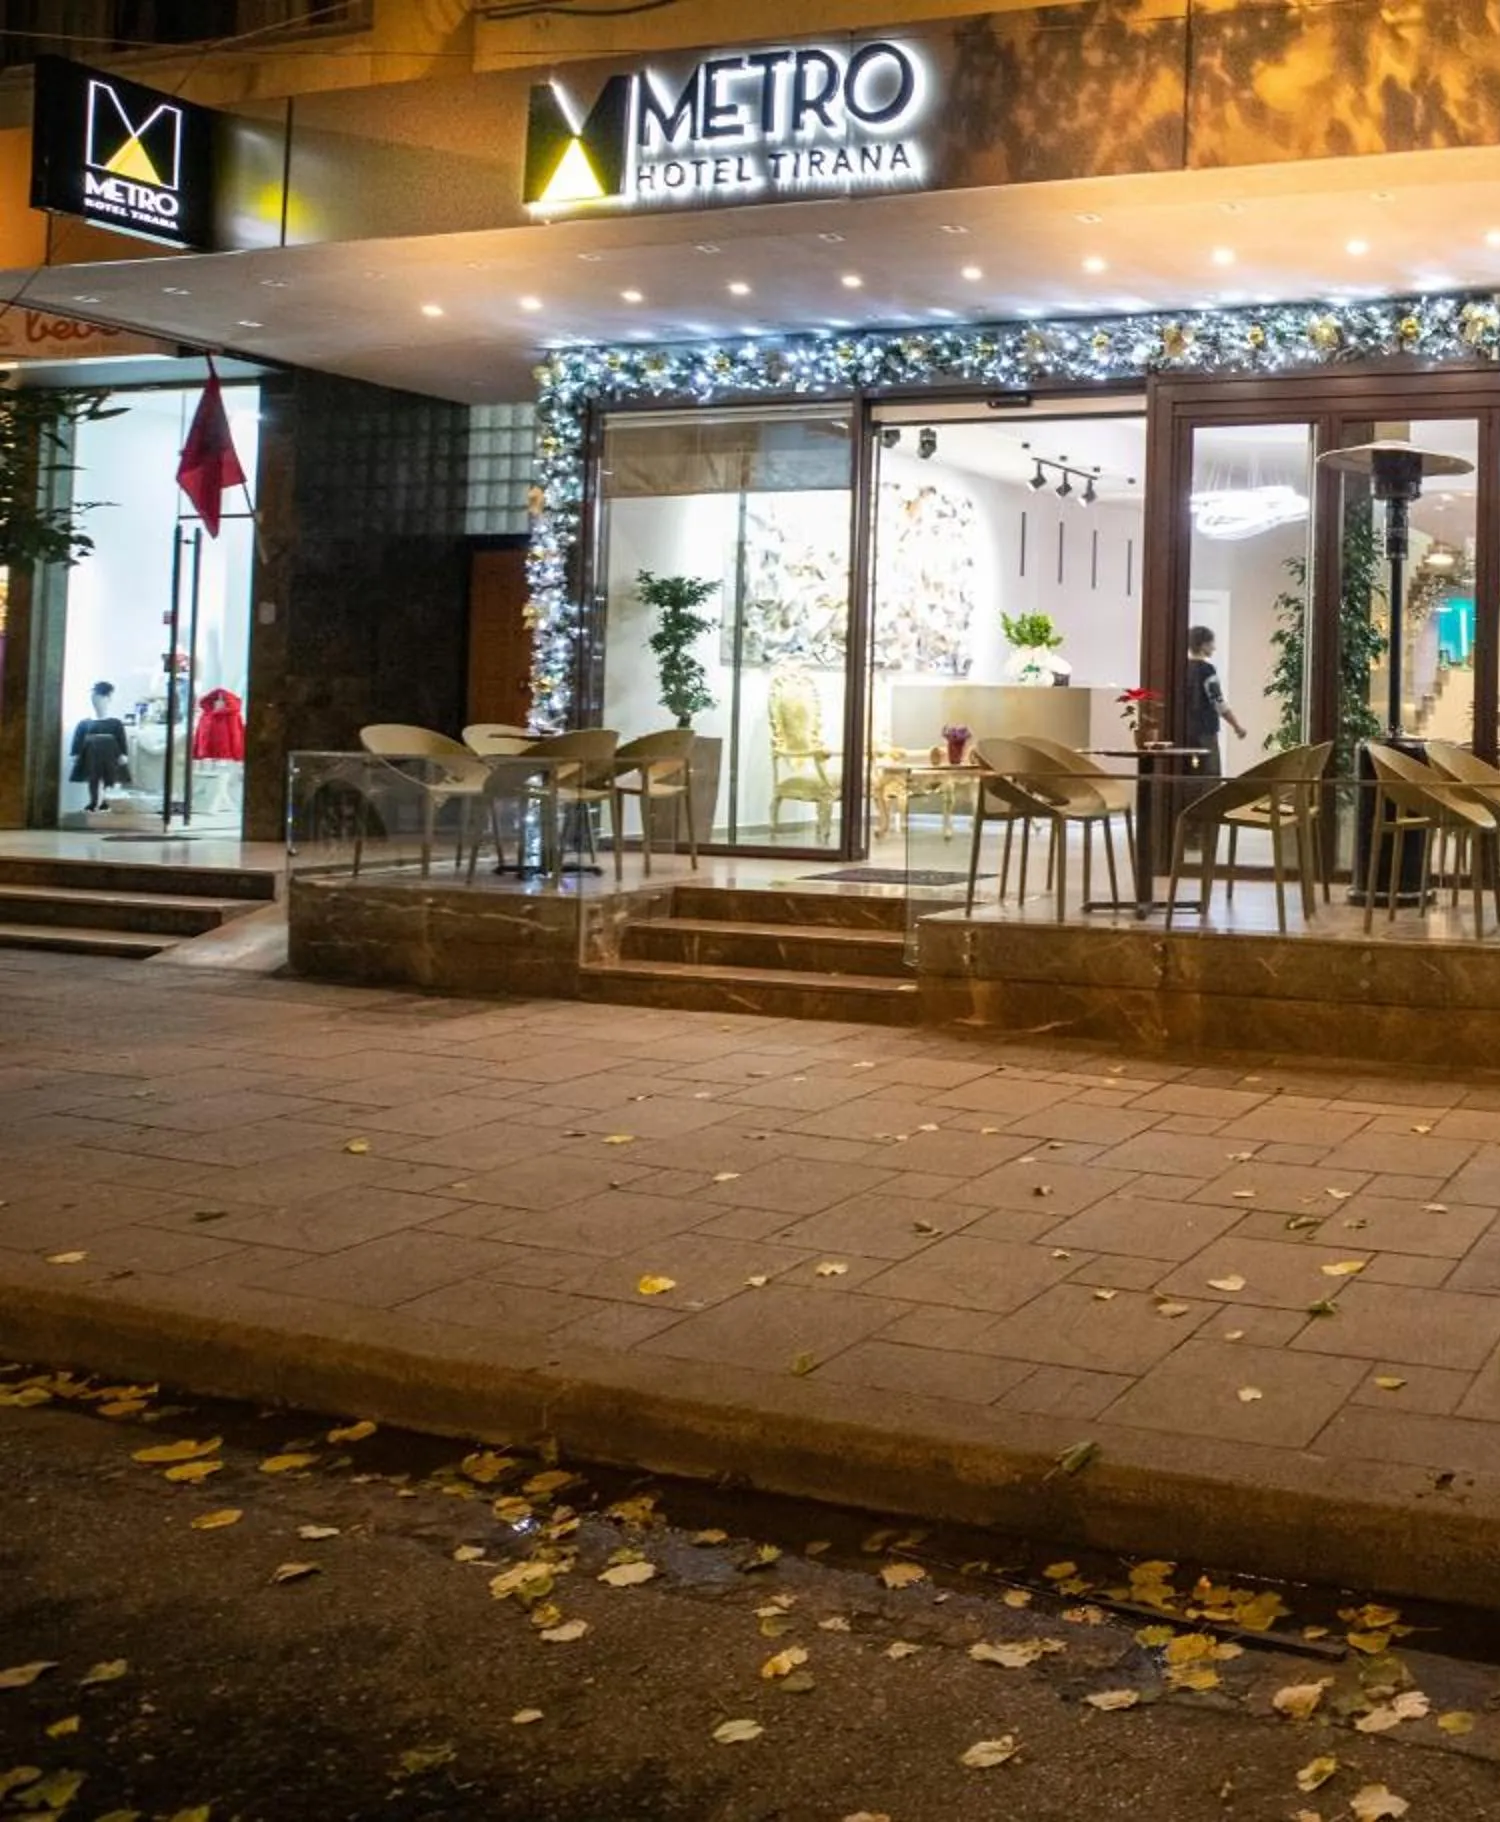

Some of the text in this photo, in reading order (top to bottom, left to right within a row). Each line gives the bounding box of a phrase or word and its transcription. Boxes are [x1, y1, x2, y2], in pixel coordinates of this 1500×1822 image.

[637, 42, 916, 147] METRO
[636, 143, 911, 191] HOTEL TIRANA
[84, 198, 179, 230] HOTEL TIRANA
[85, 171, 179, 217] METRO
